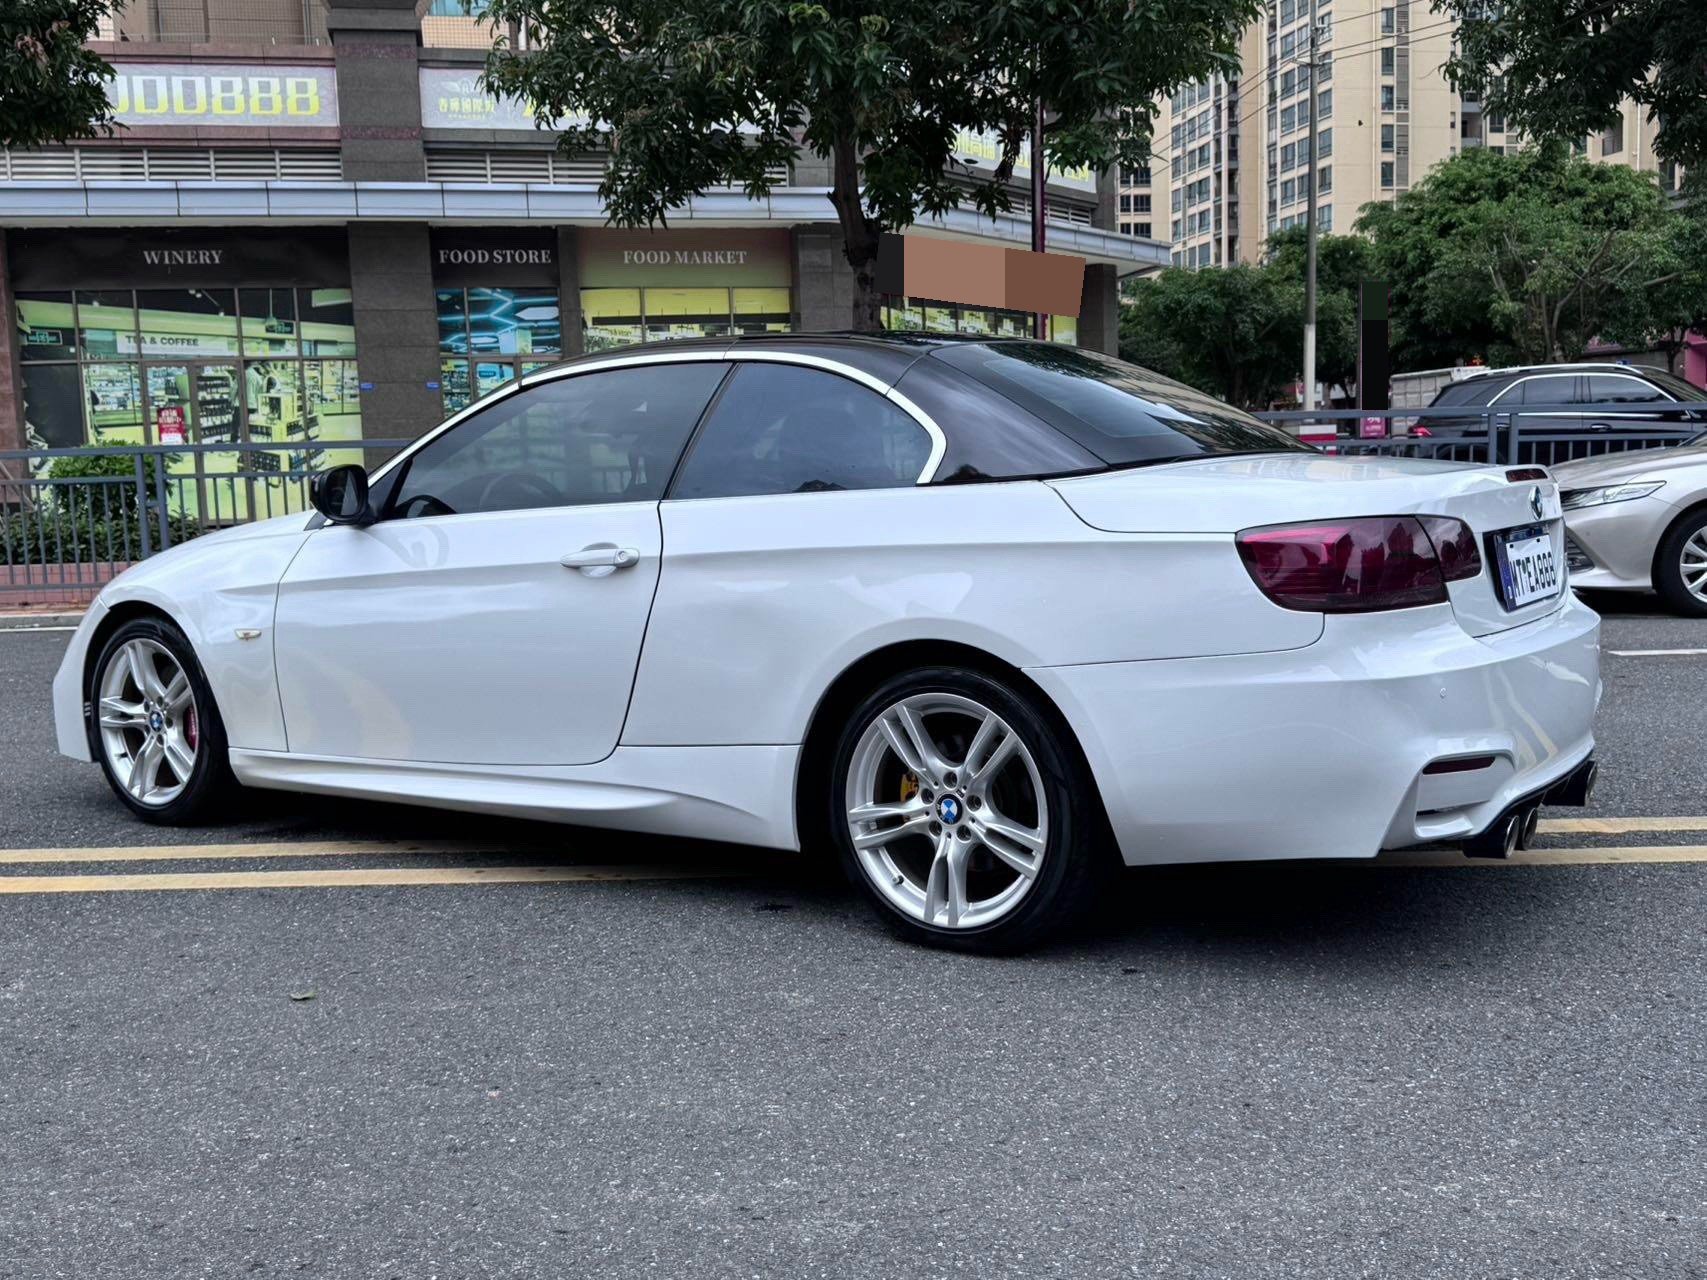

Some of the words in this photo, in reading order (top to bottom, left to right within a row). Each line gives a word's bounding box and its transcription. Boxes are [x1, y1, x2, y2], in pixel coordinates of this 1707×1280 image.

[143, 249, 222, 265] WINERY
[439, 249, 490, 264] FOOD
[493, 249, 552, 264] STORE
[623, 250, 671, 264] FOOD
[674, 250, 748, 264] MARKET
[160, 336, 199, 347] COFFEE
